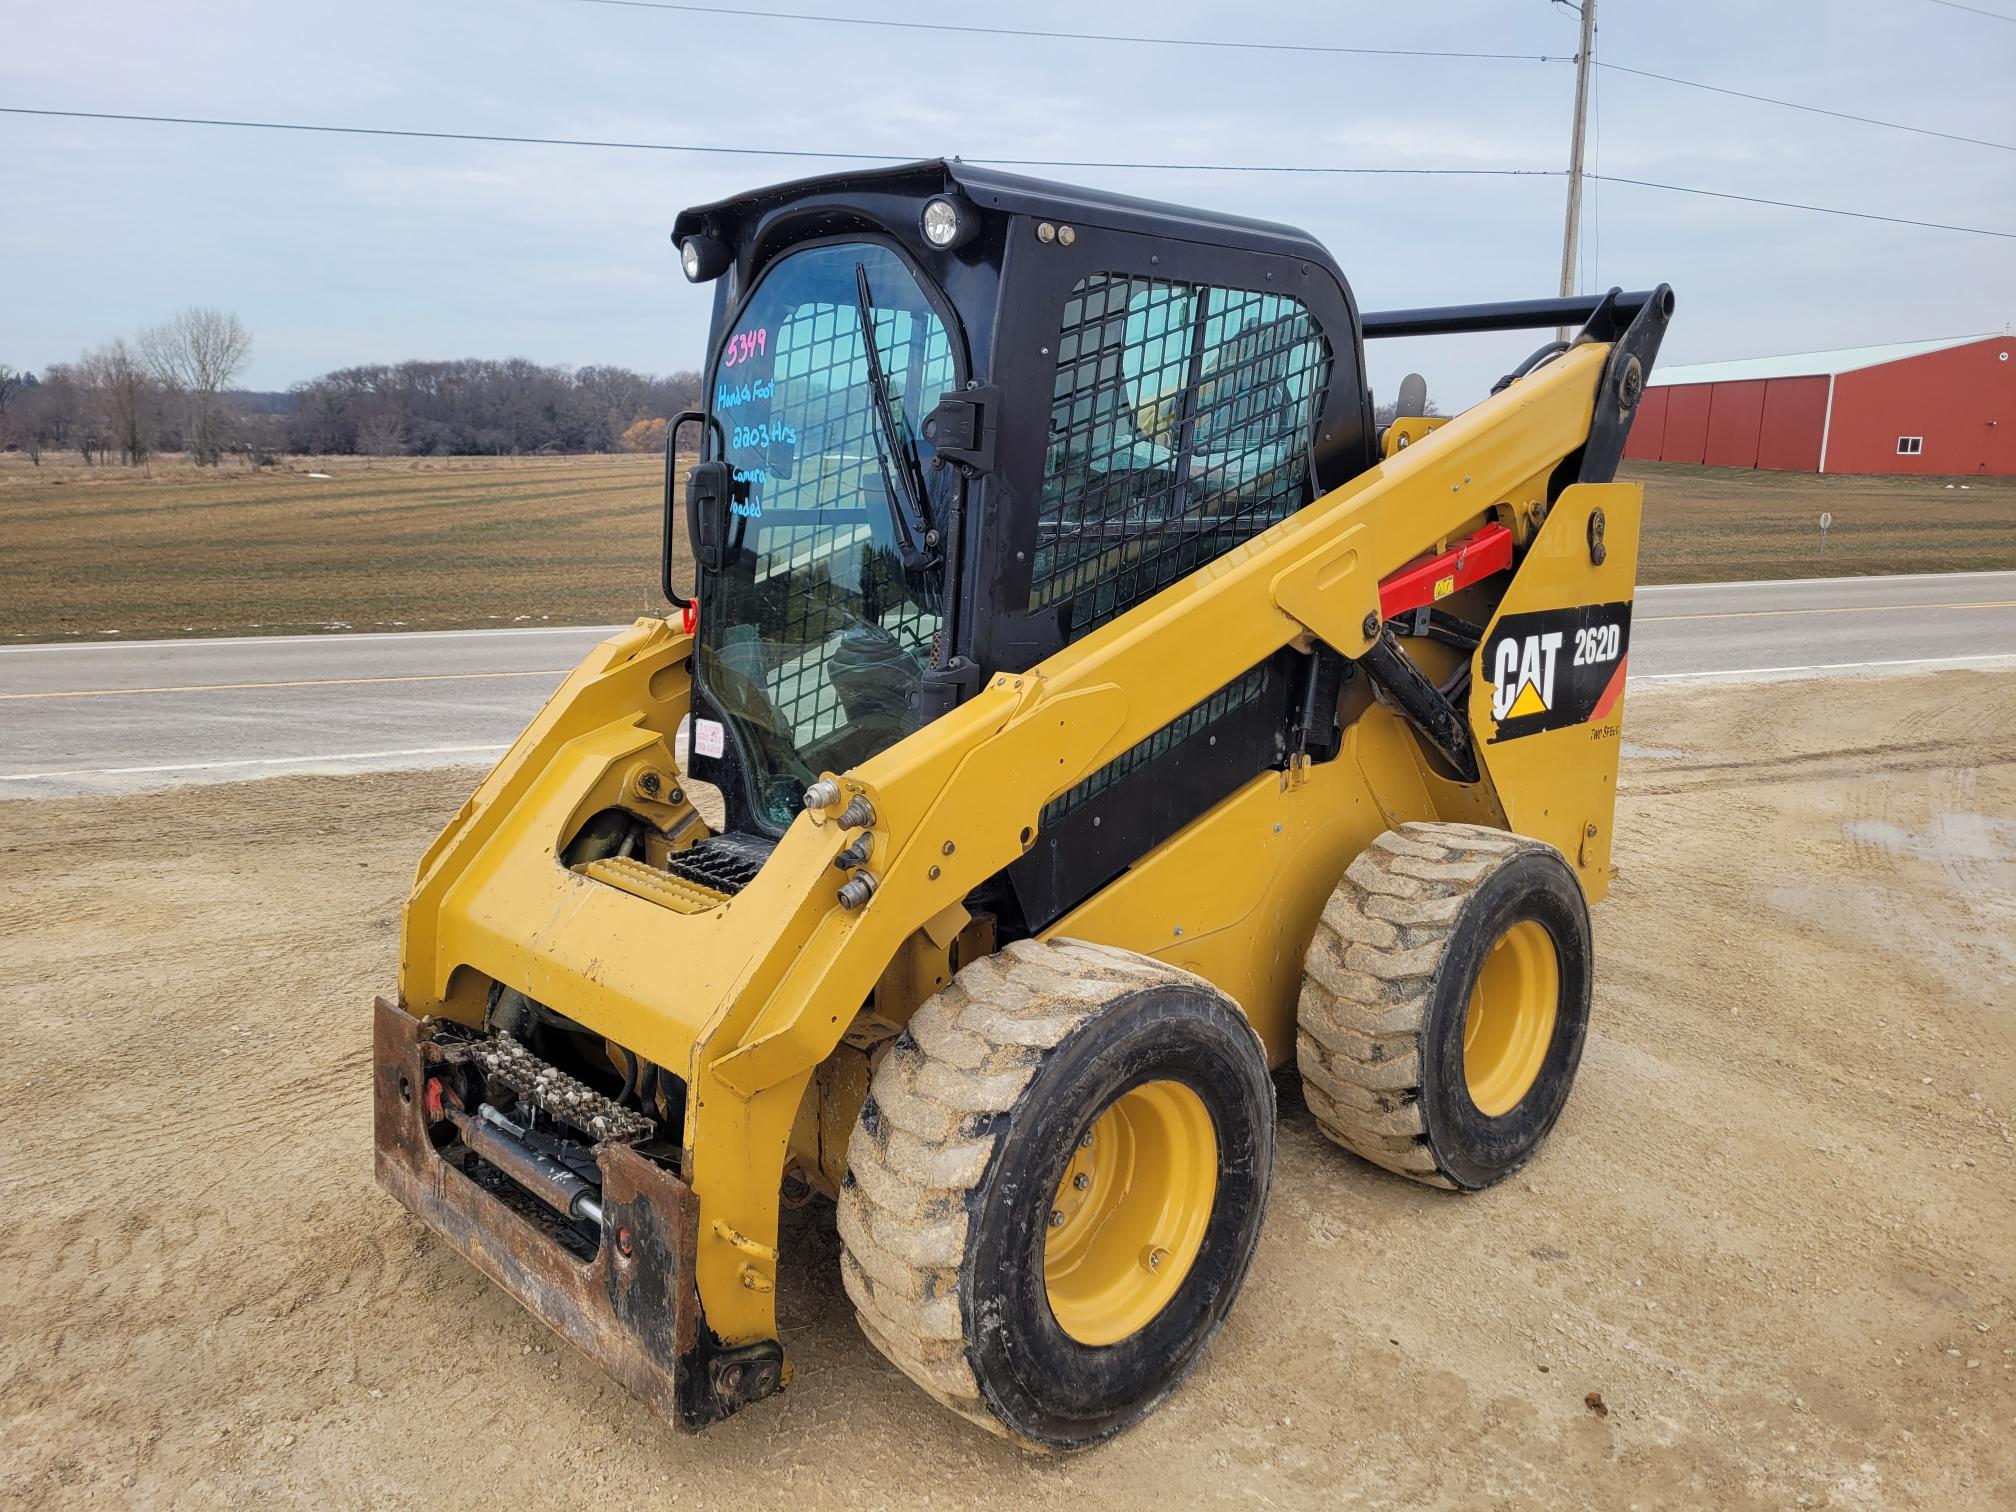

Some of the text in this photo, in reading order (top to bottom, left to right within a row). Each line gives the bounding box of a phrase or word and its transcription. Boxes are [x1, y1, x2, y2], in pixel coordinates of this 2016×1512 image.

[726, 329, 766, 366] 5349
[753, 378, 775, 402] Foot
[733, 421, 796, 449] 2203 Hrs
[1494, 624, 1620, 720] CAT 262D
